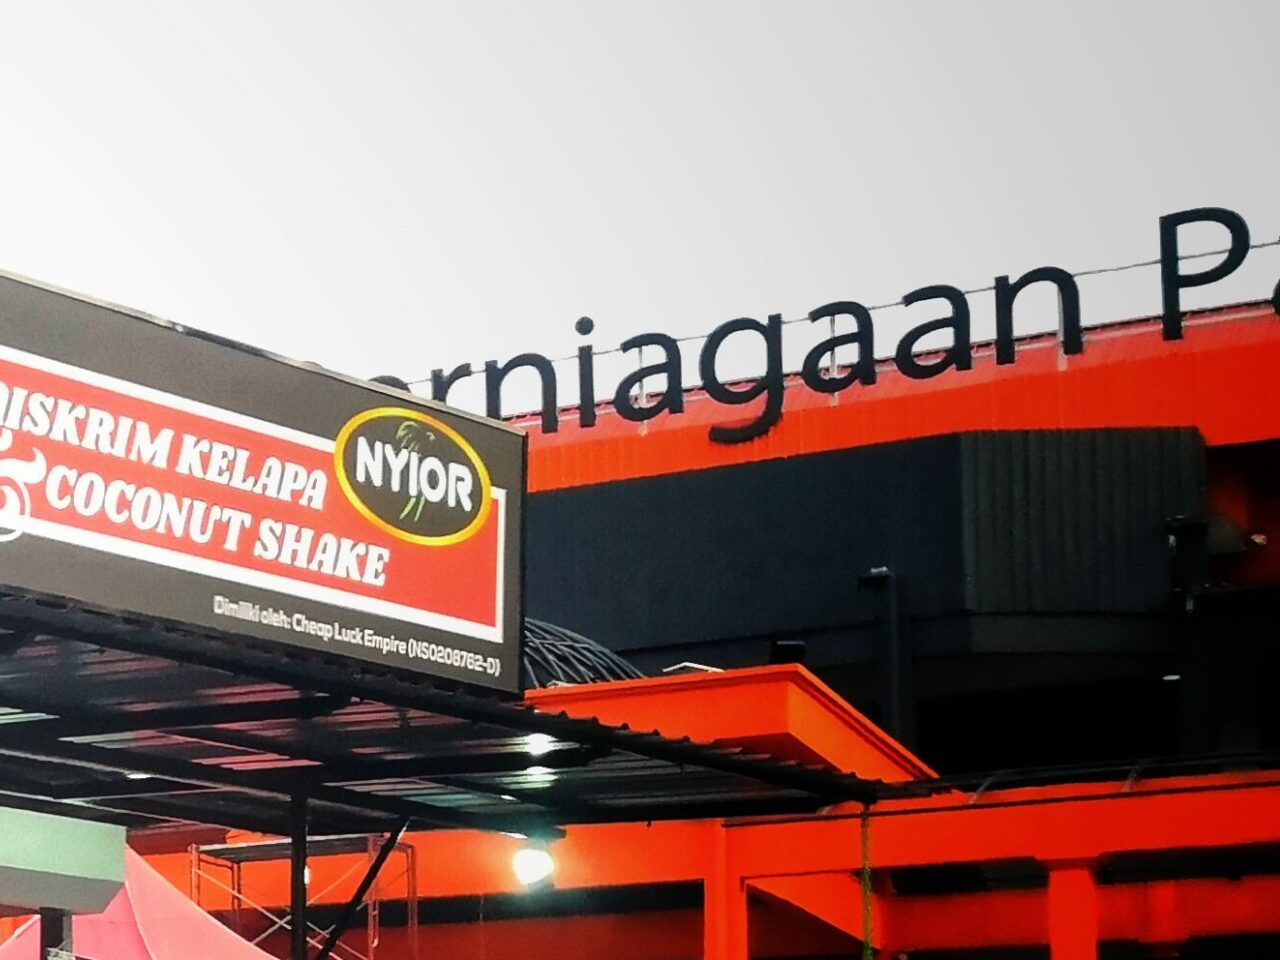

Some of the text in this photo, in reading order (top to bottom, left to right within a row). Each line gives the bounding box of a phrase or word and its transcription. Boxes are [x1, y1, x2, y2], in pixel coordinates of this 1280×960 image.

[368, 206, 1280, 444] rniagaan P
[179, 435, 328, 511] KELAPA
[356, 436, 474, 512] NYIOR
[44, 467, 253, 548] COCONUT
[253, 517, 391, 588] SHAKE
[213, 595, 260, 622] Dimiliki
[260, 606, 291, 629] oleh:
[292, 613, 333, 641] Cheap
[334, 622, 363, 645] Luck
[363, 629, 407, 655] Empire
